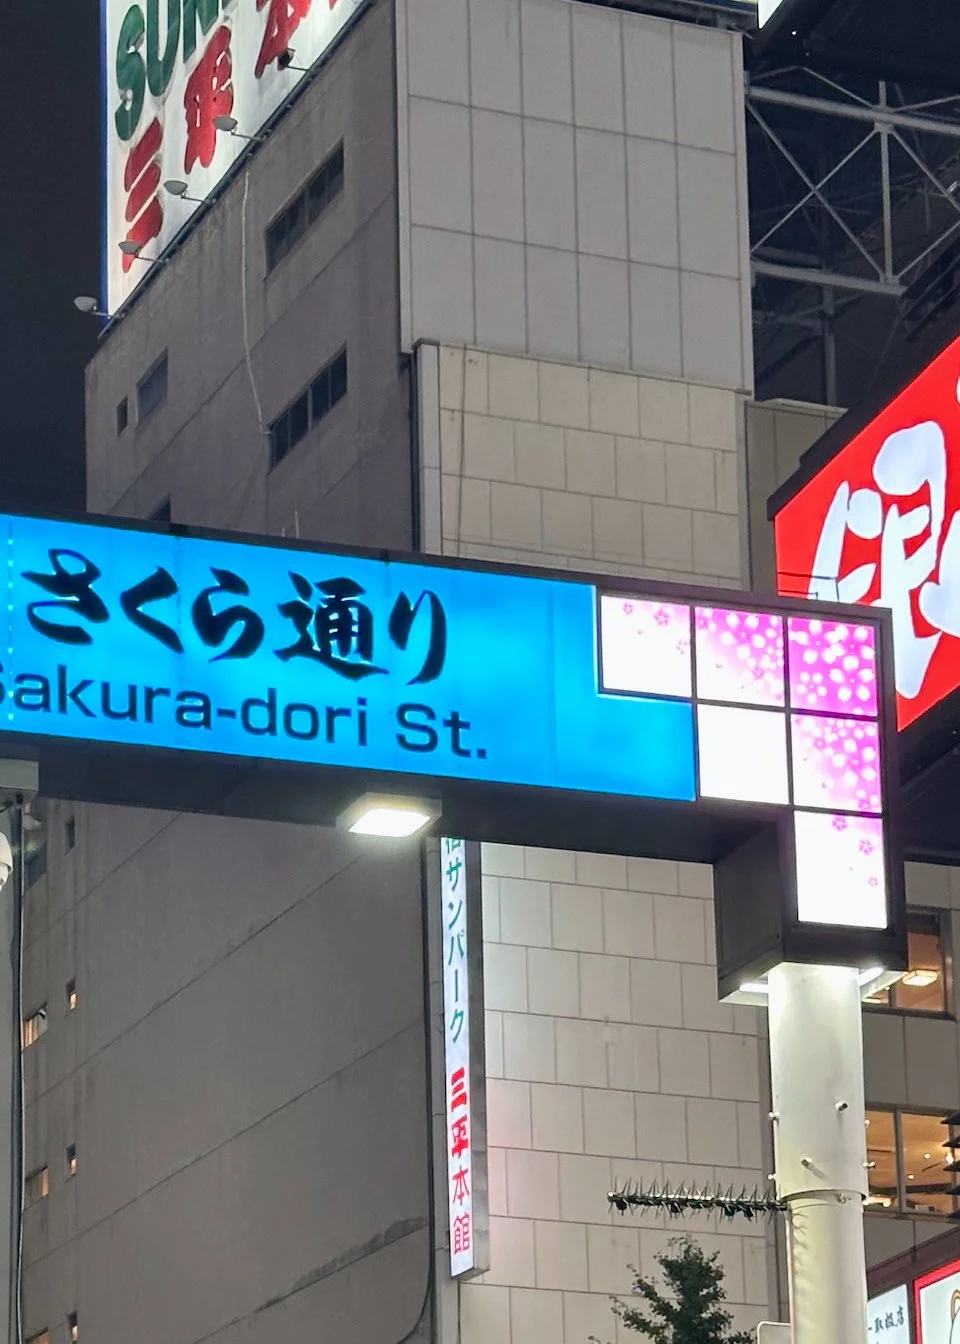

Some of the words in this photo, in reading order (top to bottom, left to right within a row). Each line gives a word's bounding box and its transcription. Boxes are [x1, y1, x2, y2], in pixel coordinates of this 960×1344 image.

[20, 548, 447, 685] さくら通り
[396, 702, 488, 759] St.
